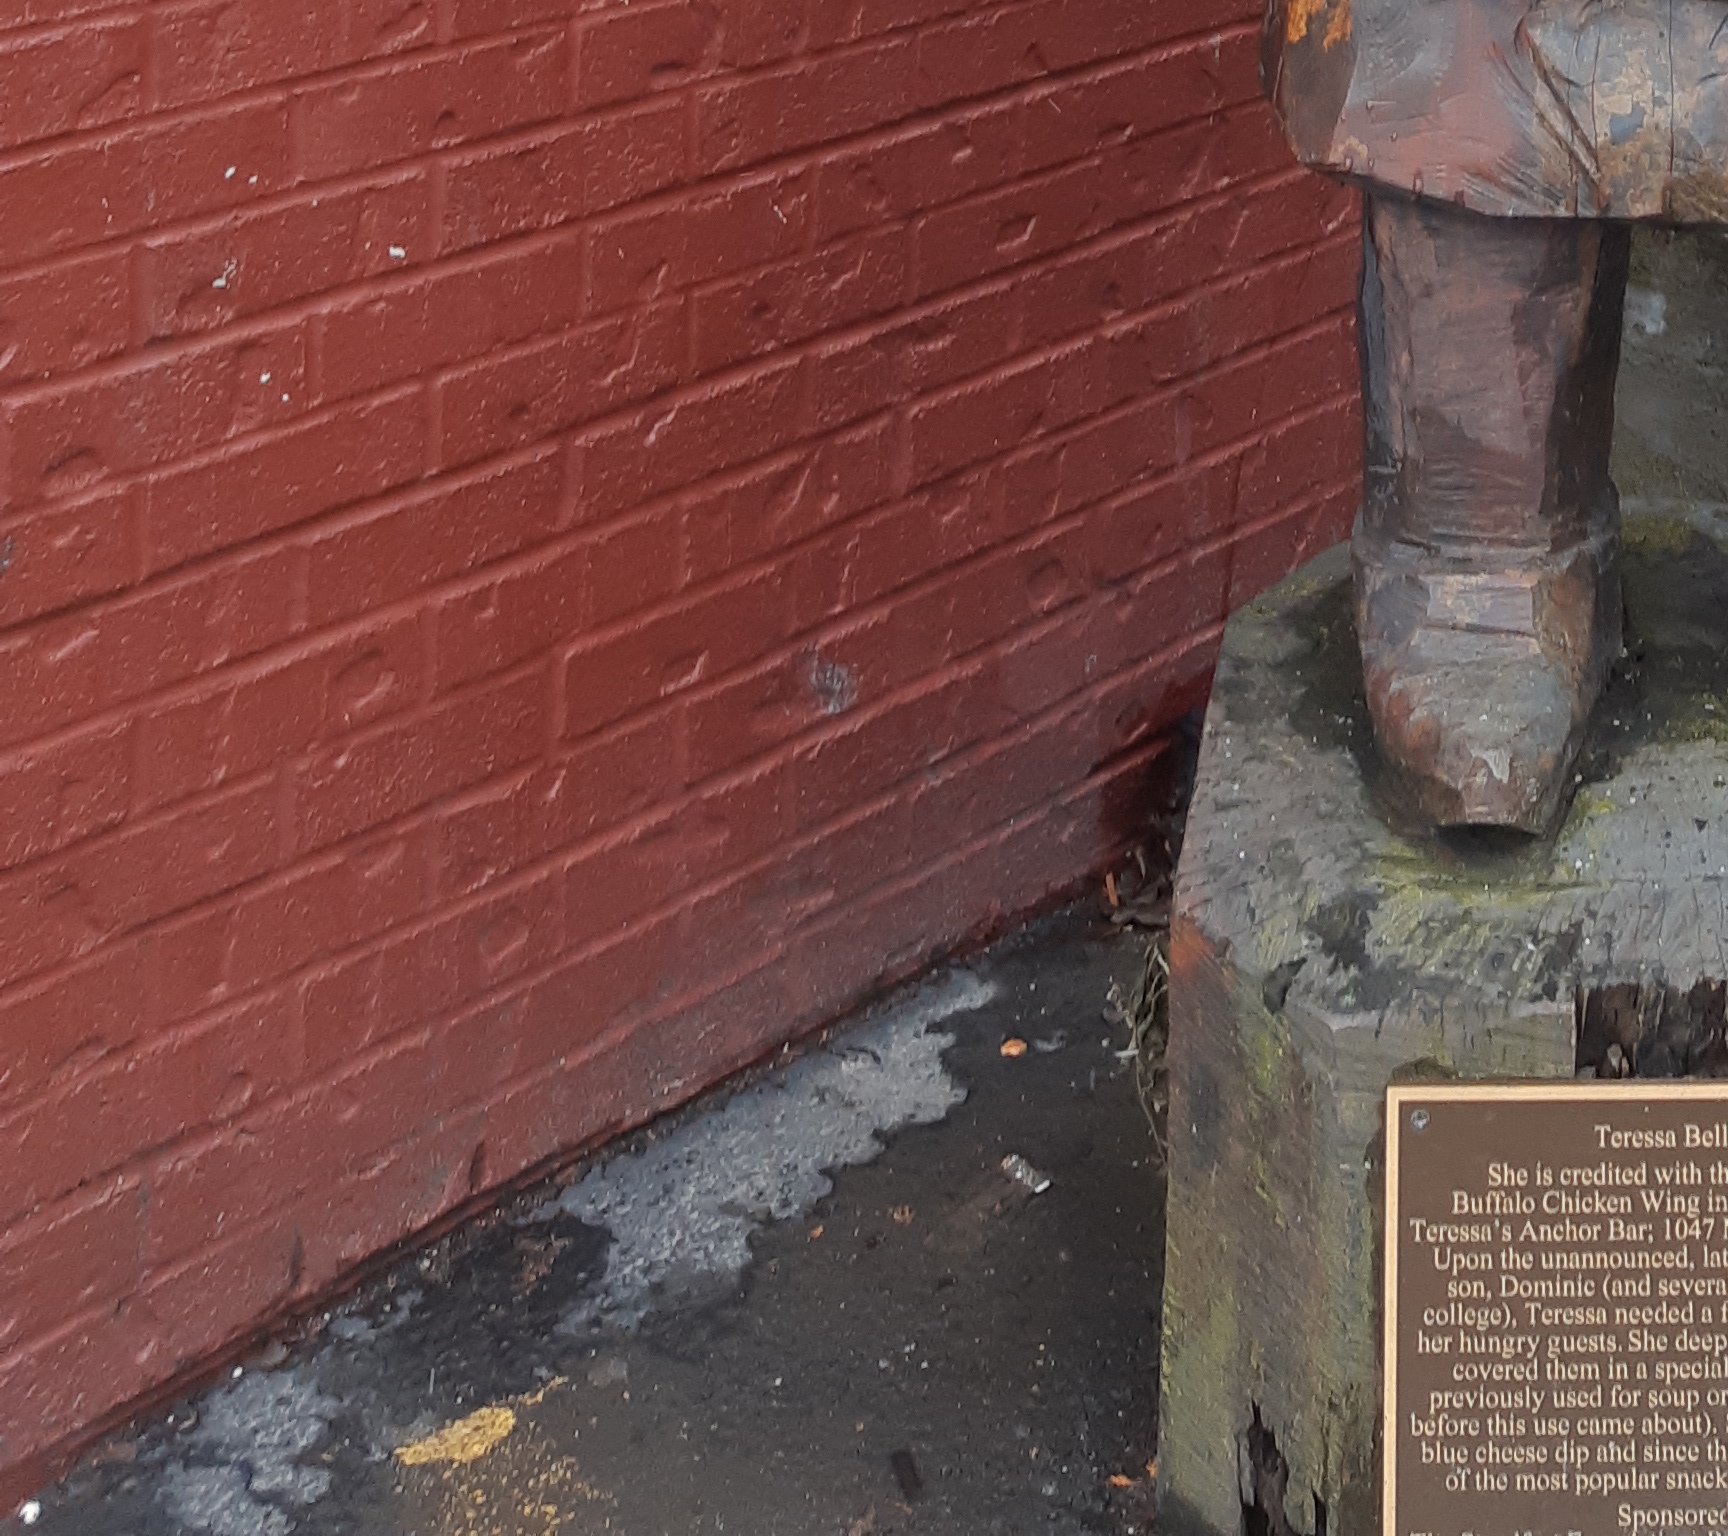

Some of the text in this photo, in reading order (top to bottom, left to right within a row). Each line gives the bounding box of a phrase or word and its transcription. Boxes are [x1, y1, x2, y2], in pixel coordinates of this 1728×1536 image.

[1594, 1123, 1677, 1149] Teressa
[1488, 1162, 1529, 1187] She
[1535, 1160, 1553, 1187] is
[1559, 1160, 1647, 1186] credited
[1654, 1160, 1702, 1186] with
[1451, 1190, 1536, 1215] Buffalo
[1542, 1189, 1632, 1215] Chicken
[1639, 1187, 1701, 1219] Wing
[1409, 1217, 1512, 1243] Teressa's
[1518, 1216, 1602, 1243] Anchor
[1608, 1218, 1654, 1244] Bar;
[1664, 1214, 1715, 1241] 1047
[1433, 1246, 1493, 1275] Upon
[1500, 1245, 1534, 1271] the
[1541, 1243, 1695, 1272] unannounced,
[1447, 1279, 1492, 1300] son,
[1499, 1272, 1596, 1298] Dominic
[1602, 1272, 1651, 1300] (and
[1423, 1299, 1517, 1331] college),
[1524, 1298, 1607, 1326] Teressa
[1614, 1300, 1694, 1325] needed
[1701, 1306, 1713, 1324] a
[1417, 1329, 1453, 1354] her
[1459, 1327, 1540, 1359] hungry
[1547, 1332, 1623, 1358] guests.
[1628, 1328, 1668, 1353] She
[1452, 1354, 1539, 1382] covered
[1545, 1354, 1600, 1381] them
[1608, 1355, 1629, 1380] in
[1636, 1361, 1648, 1380] a
[1655, 1352, 1728, 1384] special
[1429, 1382, 1546, 1414] previously
[1552, 1381, 1602, 1409] used
[1610, 1384, 1642, 1408] for
[1648, 1389, 1700, 1412] soup
[1410, 1411, 1480, 1437] before
[1486, 1411, 1526, 1437] this
[1531, 1417, 1570, 1436] use
[1576, 1416, 1635, 1436] came
[1641, 1408, 1717, 1440] about).
[1420, 1440, 1469, 1467] blue
[1475, 1438, 1548, 1464] cheese
[1554, 1438, 1590, 1469] dip
[1596, 1438, 1636, 1464] and
[1643, 1437, 1700, 1463] since
[1445, 1464, 1471, 1492] of
[1475, 1467, 1508, 1492] the
[1515, 1463, 1569, 1491] most
[1575, 1463, 1660, 1495] popular
